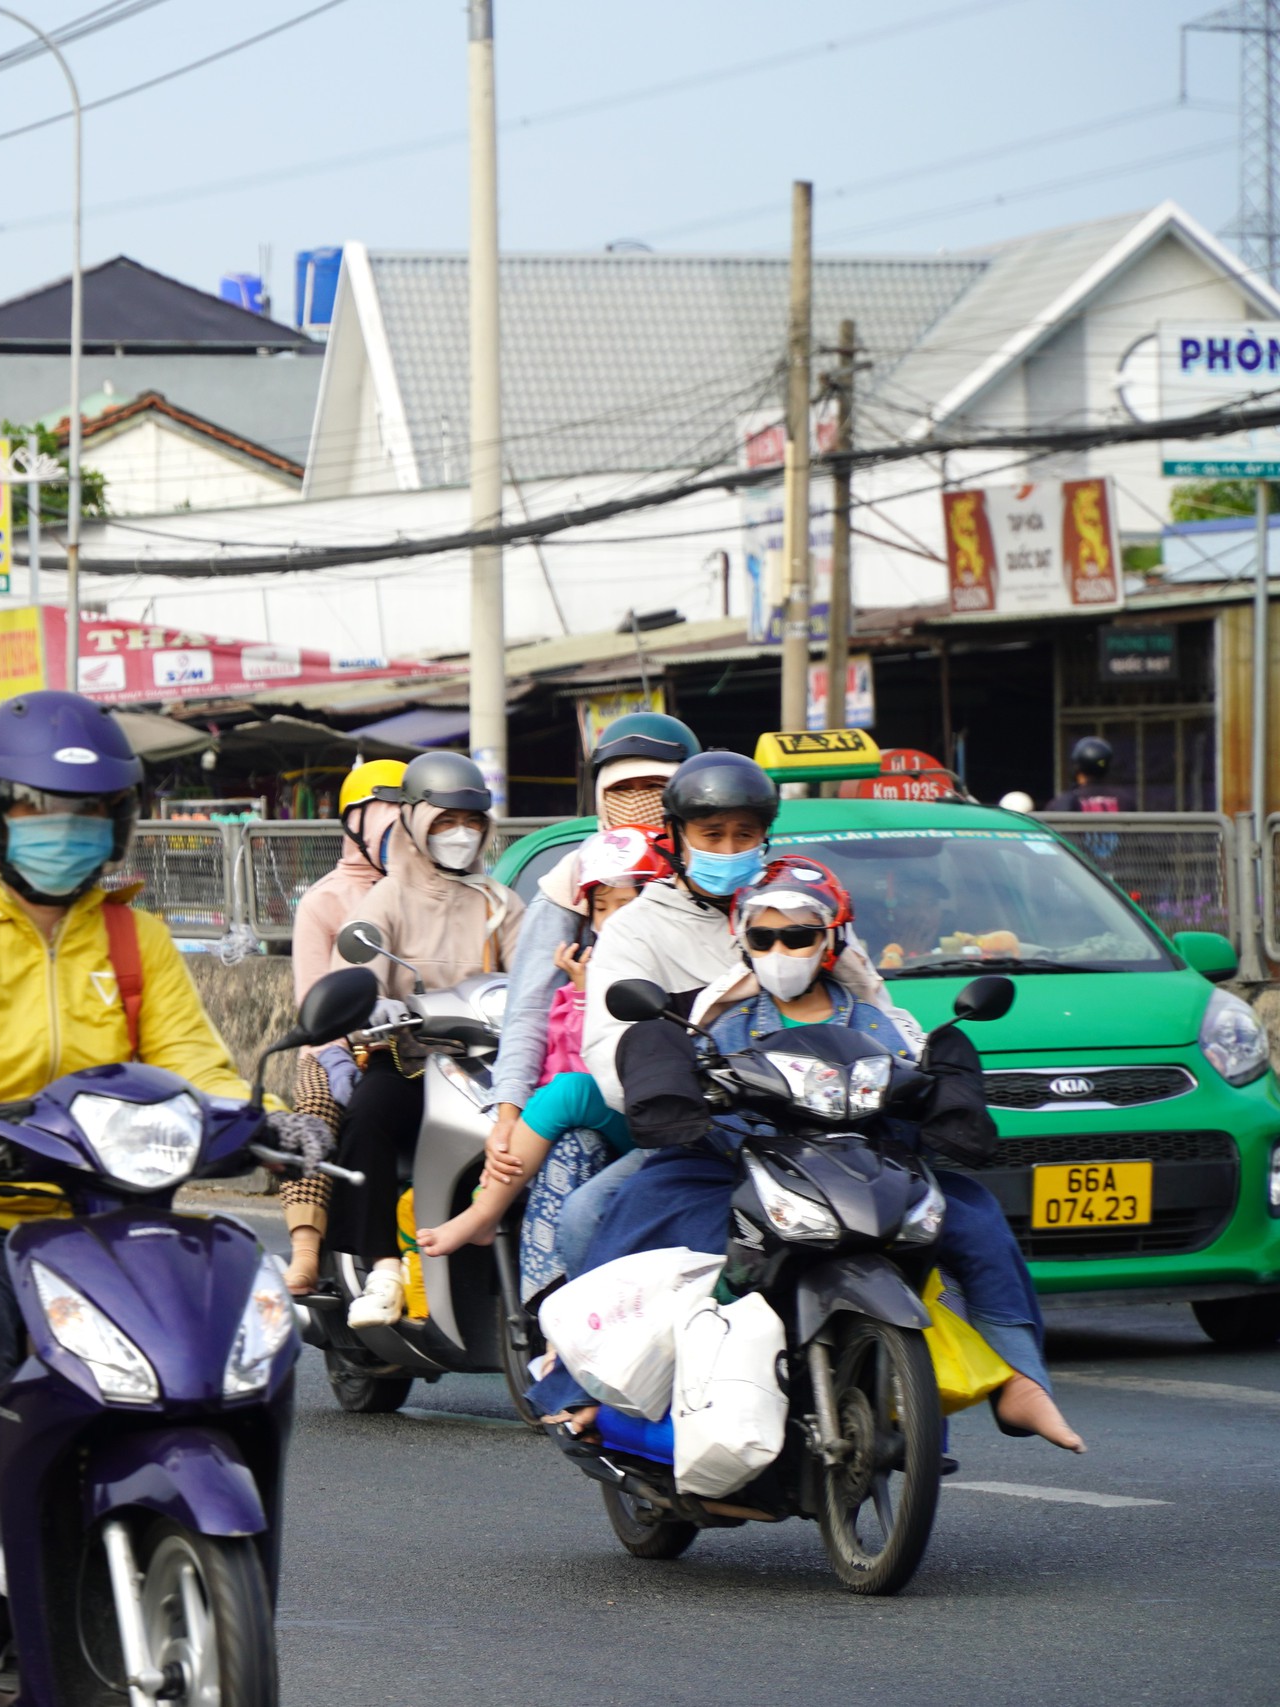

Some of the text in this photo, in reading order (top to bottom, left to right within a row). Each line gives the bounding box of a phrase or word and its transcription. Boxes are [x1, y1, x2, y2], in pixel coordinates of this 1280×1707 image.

[873, 781, 939, 799] Km 1935
[1058, 1079, 1088, 1093] KIA
[1067, 1166, 1117, 1194] 66A
[1045, 1195, 1138, 1225] 074.23
